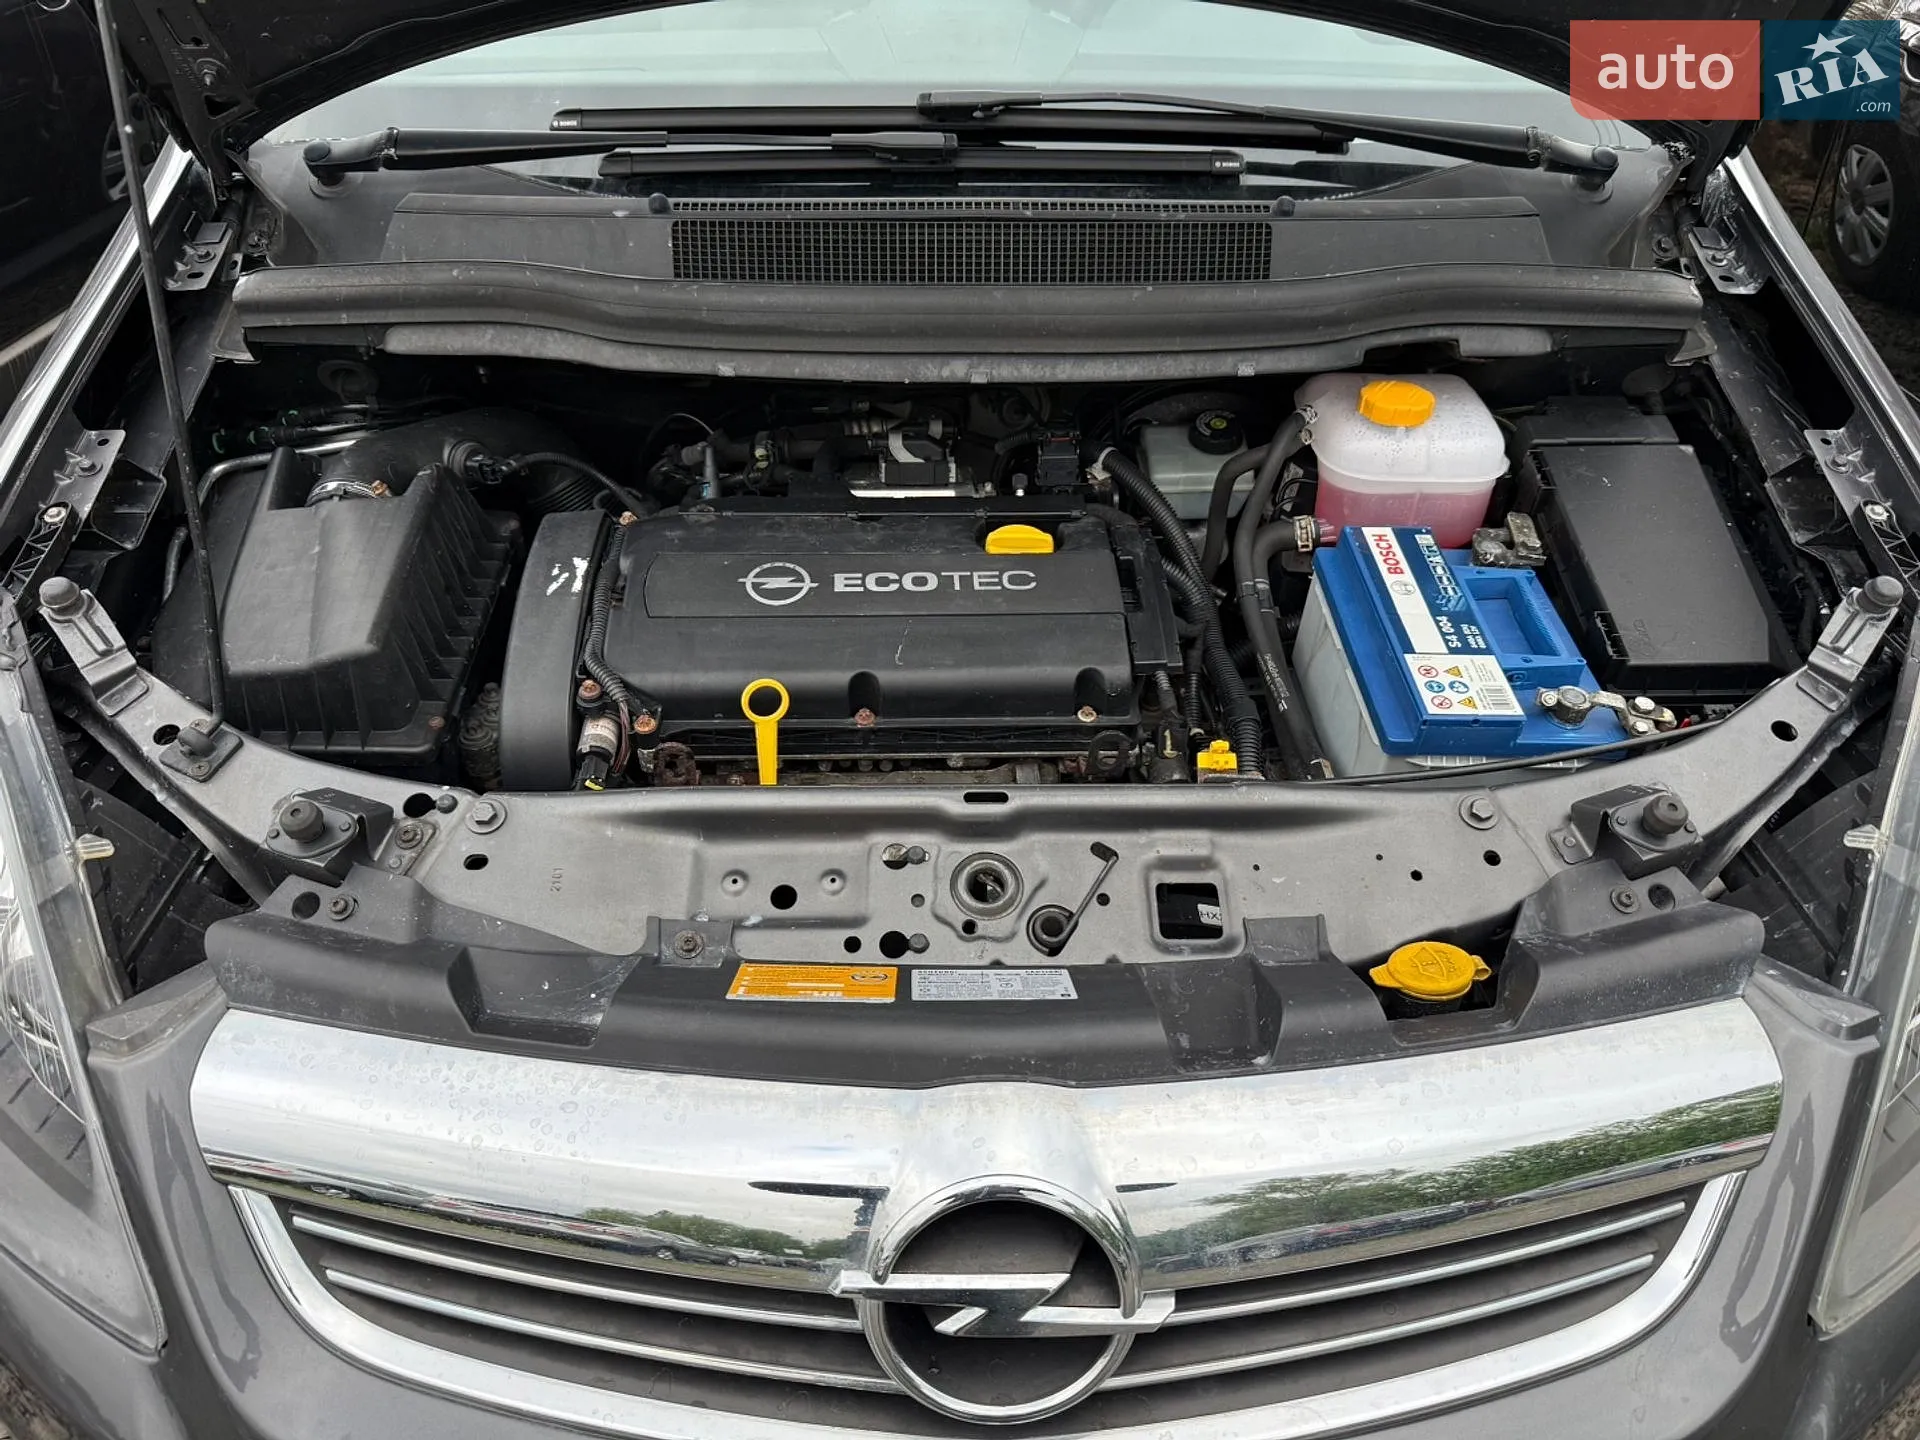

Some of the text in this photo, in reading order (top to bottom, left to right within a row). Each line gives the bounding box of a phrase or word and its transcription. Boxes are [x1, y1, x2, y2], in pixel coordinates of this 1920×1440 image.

[1371, 534, 1405, 575] BOSCH
[834, 570, 1037, 592] ECOTEC
[1436, 616, 1462, 648] S4 004
